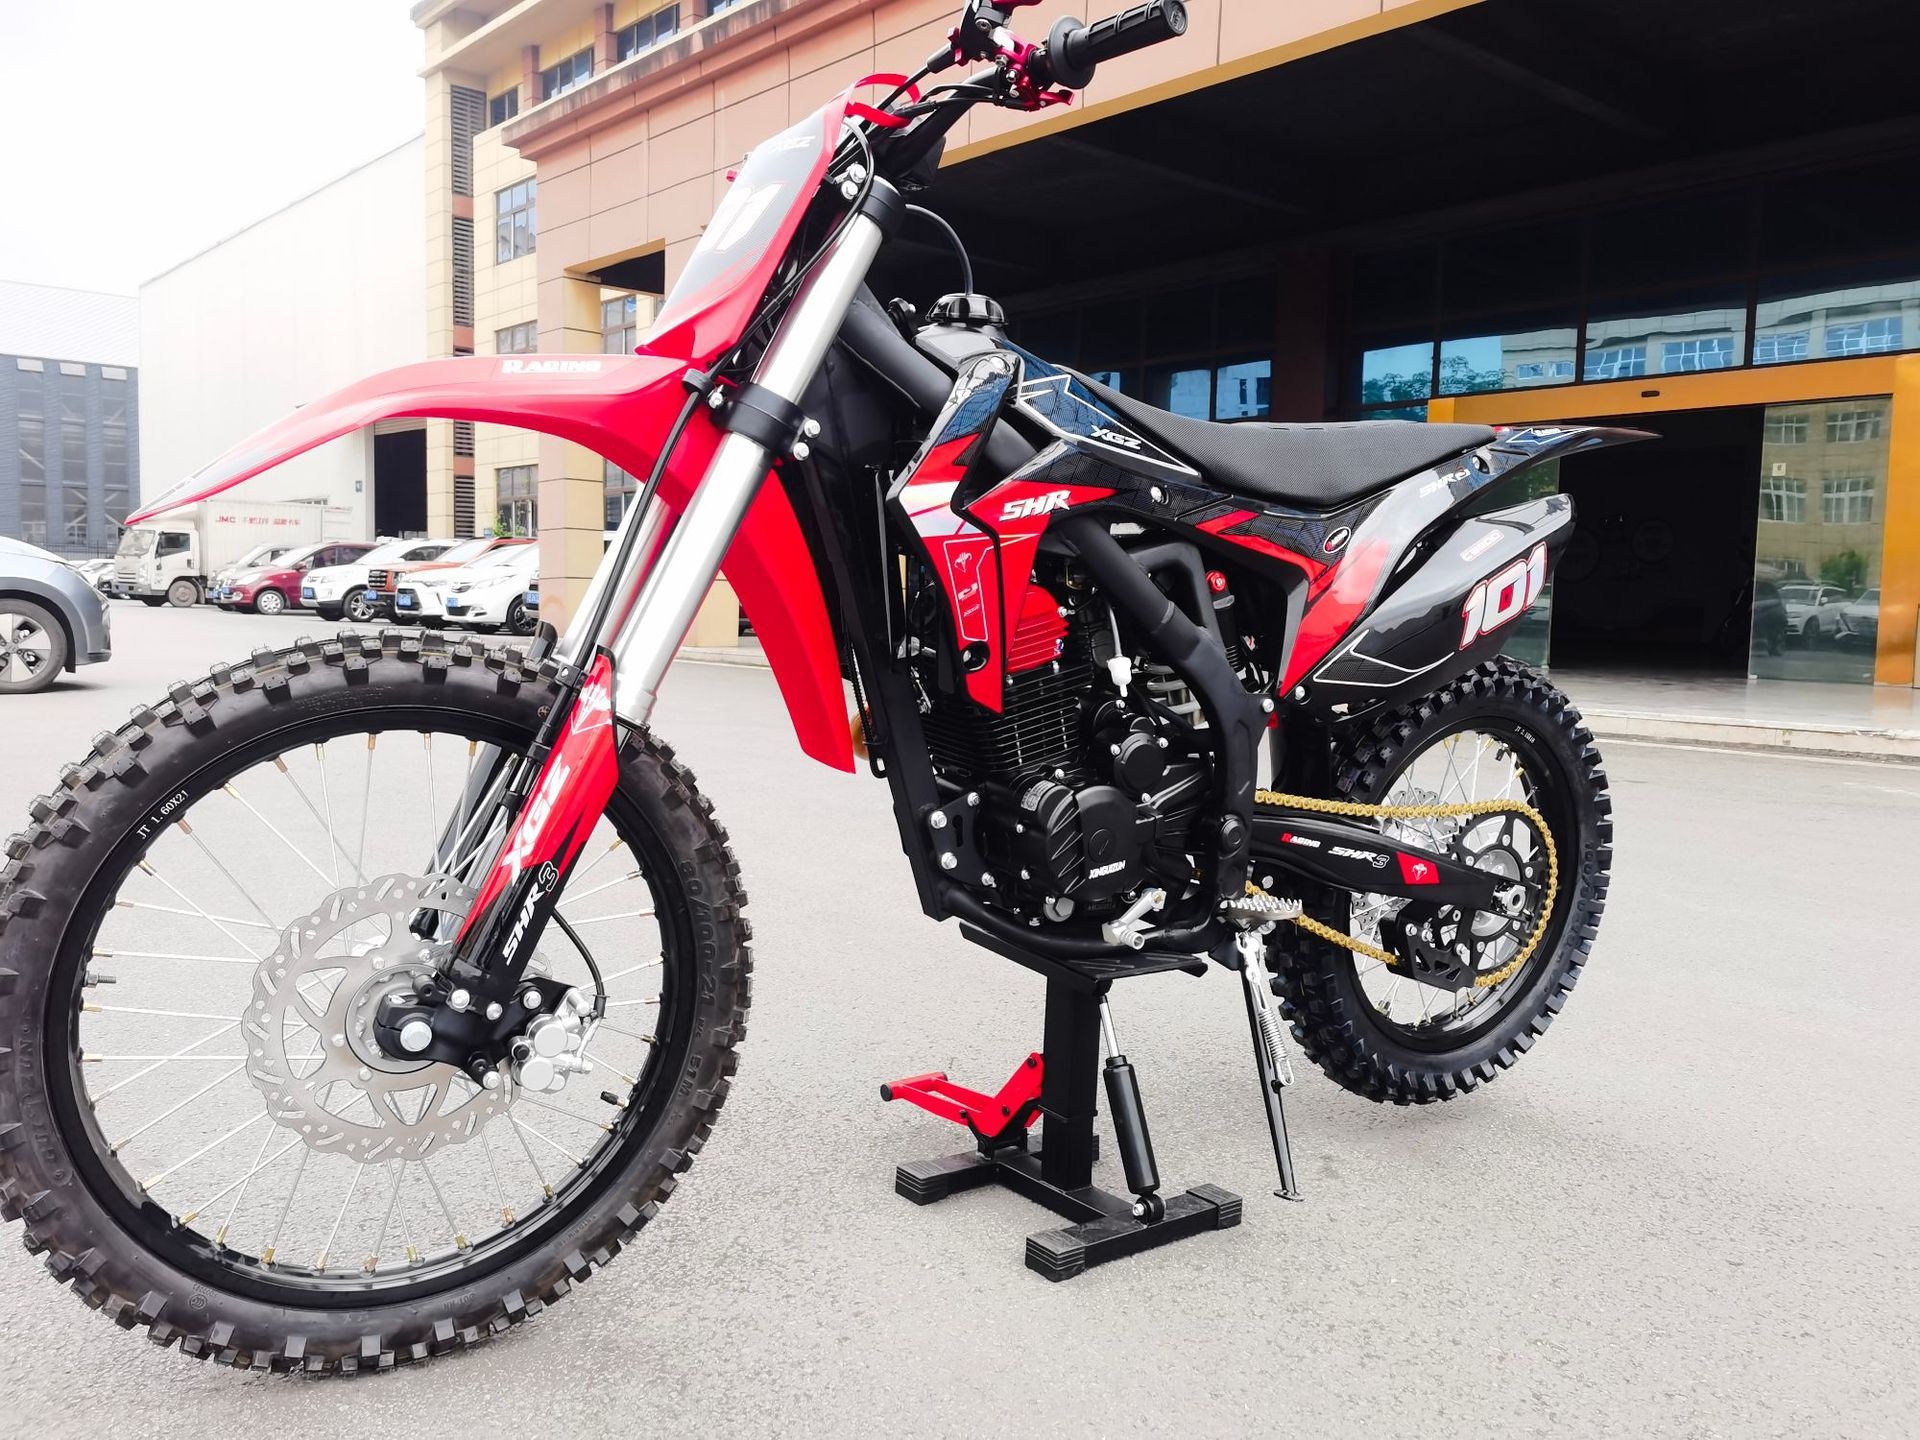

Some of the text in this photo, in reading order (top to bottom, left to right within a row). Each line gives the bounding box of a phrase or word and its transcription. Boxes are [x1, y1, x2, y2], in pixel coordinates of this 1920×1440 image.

[1090, 424, 1142, 450] XGZ
[999, 489, 1072, 521] SHR
[1459, 541, 1548, 650] 101
[136, 824, 151, 840] JT
[500, 752, 571, 887] XGZ
